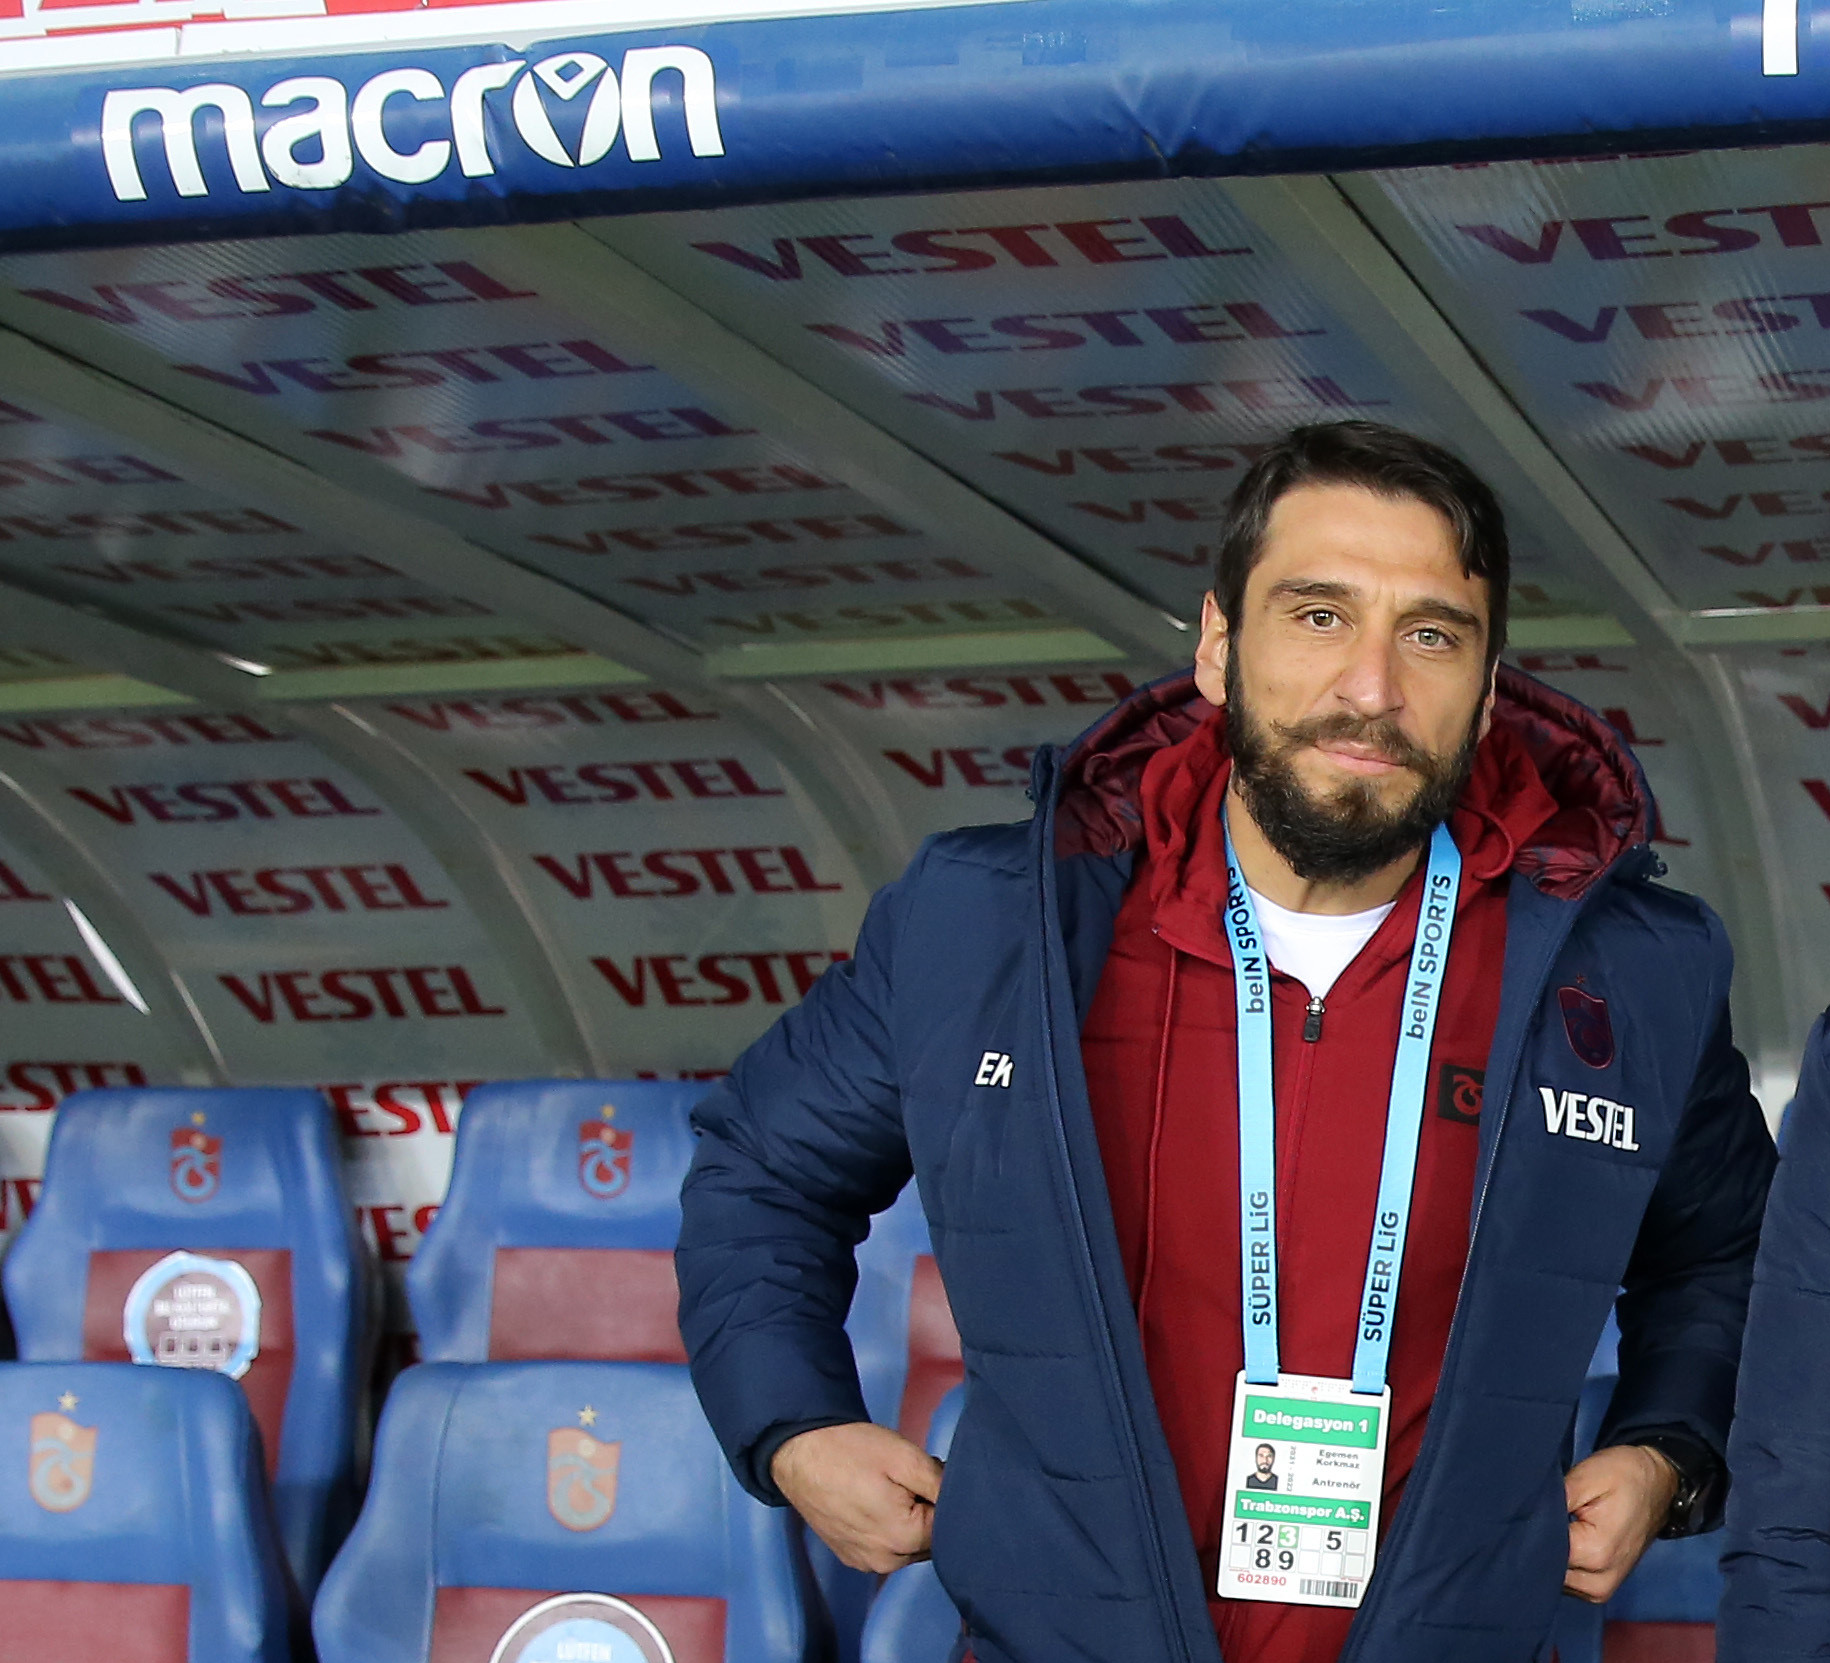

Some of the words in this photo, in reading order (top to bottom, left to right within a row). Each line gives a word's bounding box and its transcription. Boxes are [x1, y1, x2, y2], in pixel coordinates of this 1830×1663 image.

[100, 45, 725, 202] macron
[690, 215, 1257, 283] VESTEL
[18, 259, 540, 324] VESTEL
[803, 302, 1325, 357] VESTEL
[170, 338, 657, 395] VESTEL
[902, 376, 1390, 420] VESTEL
[302, 407, 758, 458] VESTEL
[418, 464, 850, 510] VESTEL
[0, 508, 303, 540] ESTEL
[525, 513, 922, 555] VESTEL
[620, 557, 992, 596] VESTEL
[382, 690, 722, 732] VESTEL
[65, 776, 384, 827] VESTEL
[462, 756, 785, 809] VESTEL
[148, 861, 452, 919] VESTEL
[531, 845, 843, 900] VESTEL
[1418, 874, 1451, 975] SPORTS
[217, 963, 508, 1026] VESTEL
[1242, 956, 1265, 1013] beIN
[1405, 981, 1433, 1040] beIN
[1538, 1086, 1641, 1152] VESTEL
[1248, 1240, 1271, 1326] SÜPER
[1362, 1259, 1393, 1342] SÜPER
[1253, 1408, 1355, 1433] Delegasyon
[1358, 1418, 1369, 1434] 1
[1319, 1449, 1359, 1461] Egemen
[1240, 1498, 1333, 1518] Trabzonspor
[1236, 1523, 1248, 1543] 1
[1257, 1524, 1274, 1545] 2
[1279, 1526, 1297, 1545] 3
[1326, 1530, 1342, 1550] 5
[1255, 1549, 1271, 1569] 8
[1278, 1550, 1294, 1570] 9
[1237, 1574, 1287, 1587] 602890
